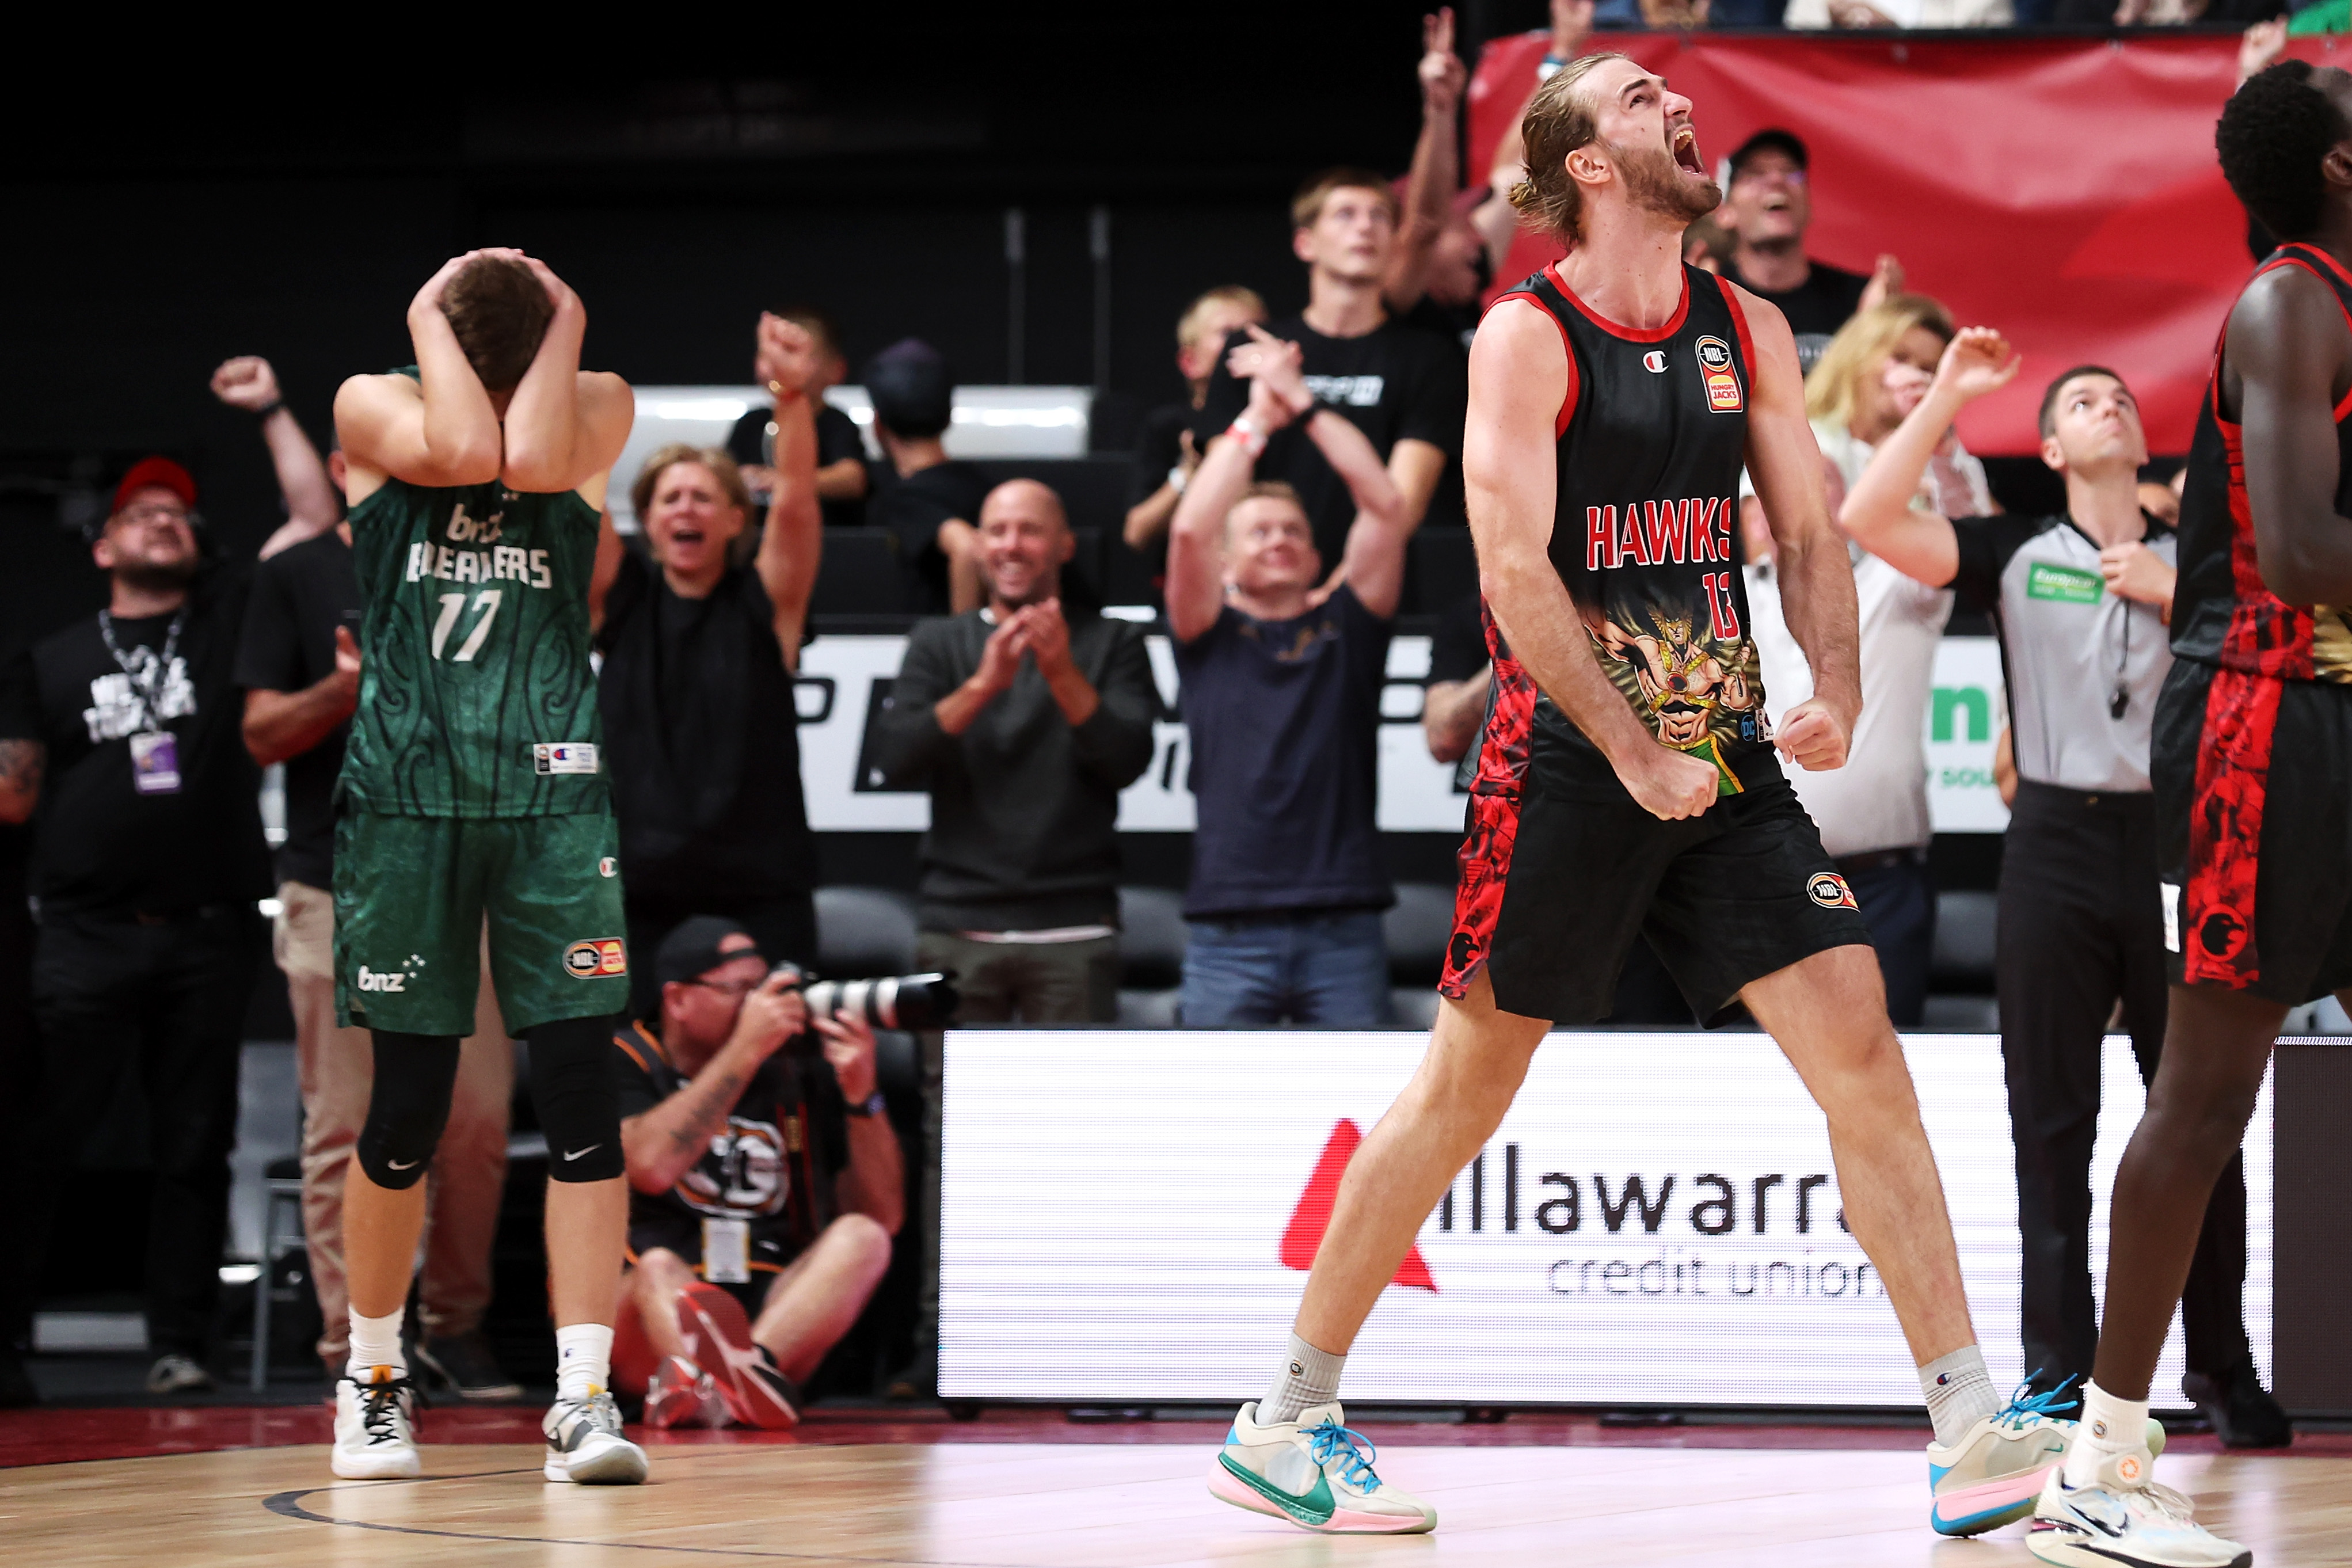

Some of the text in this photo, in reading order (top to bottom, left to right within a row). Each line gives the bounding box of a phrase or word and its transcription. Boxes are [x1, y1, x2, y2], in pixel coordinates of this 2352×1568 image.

[1703, 347, 1725, 361] NBL
[431, 589, 503, 662] 17
[1742, 721, 1755, 736] DC
[357, 965, 406, 992] bnz
[1441, 1142, 1852, 1235] illawarr
[1550, 1245, 1710, 1294] credit
